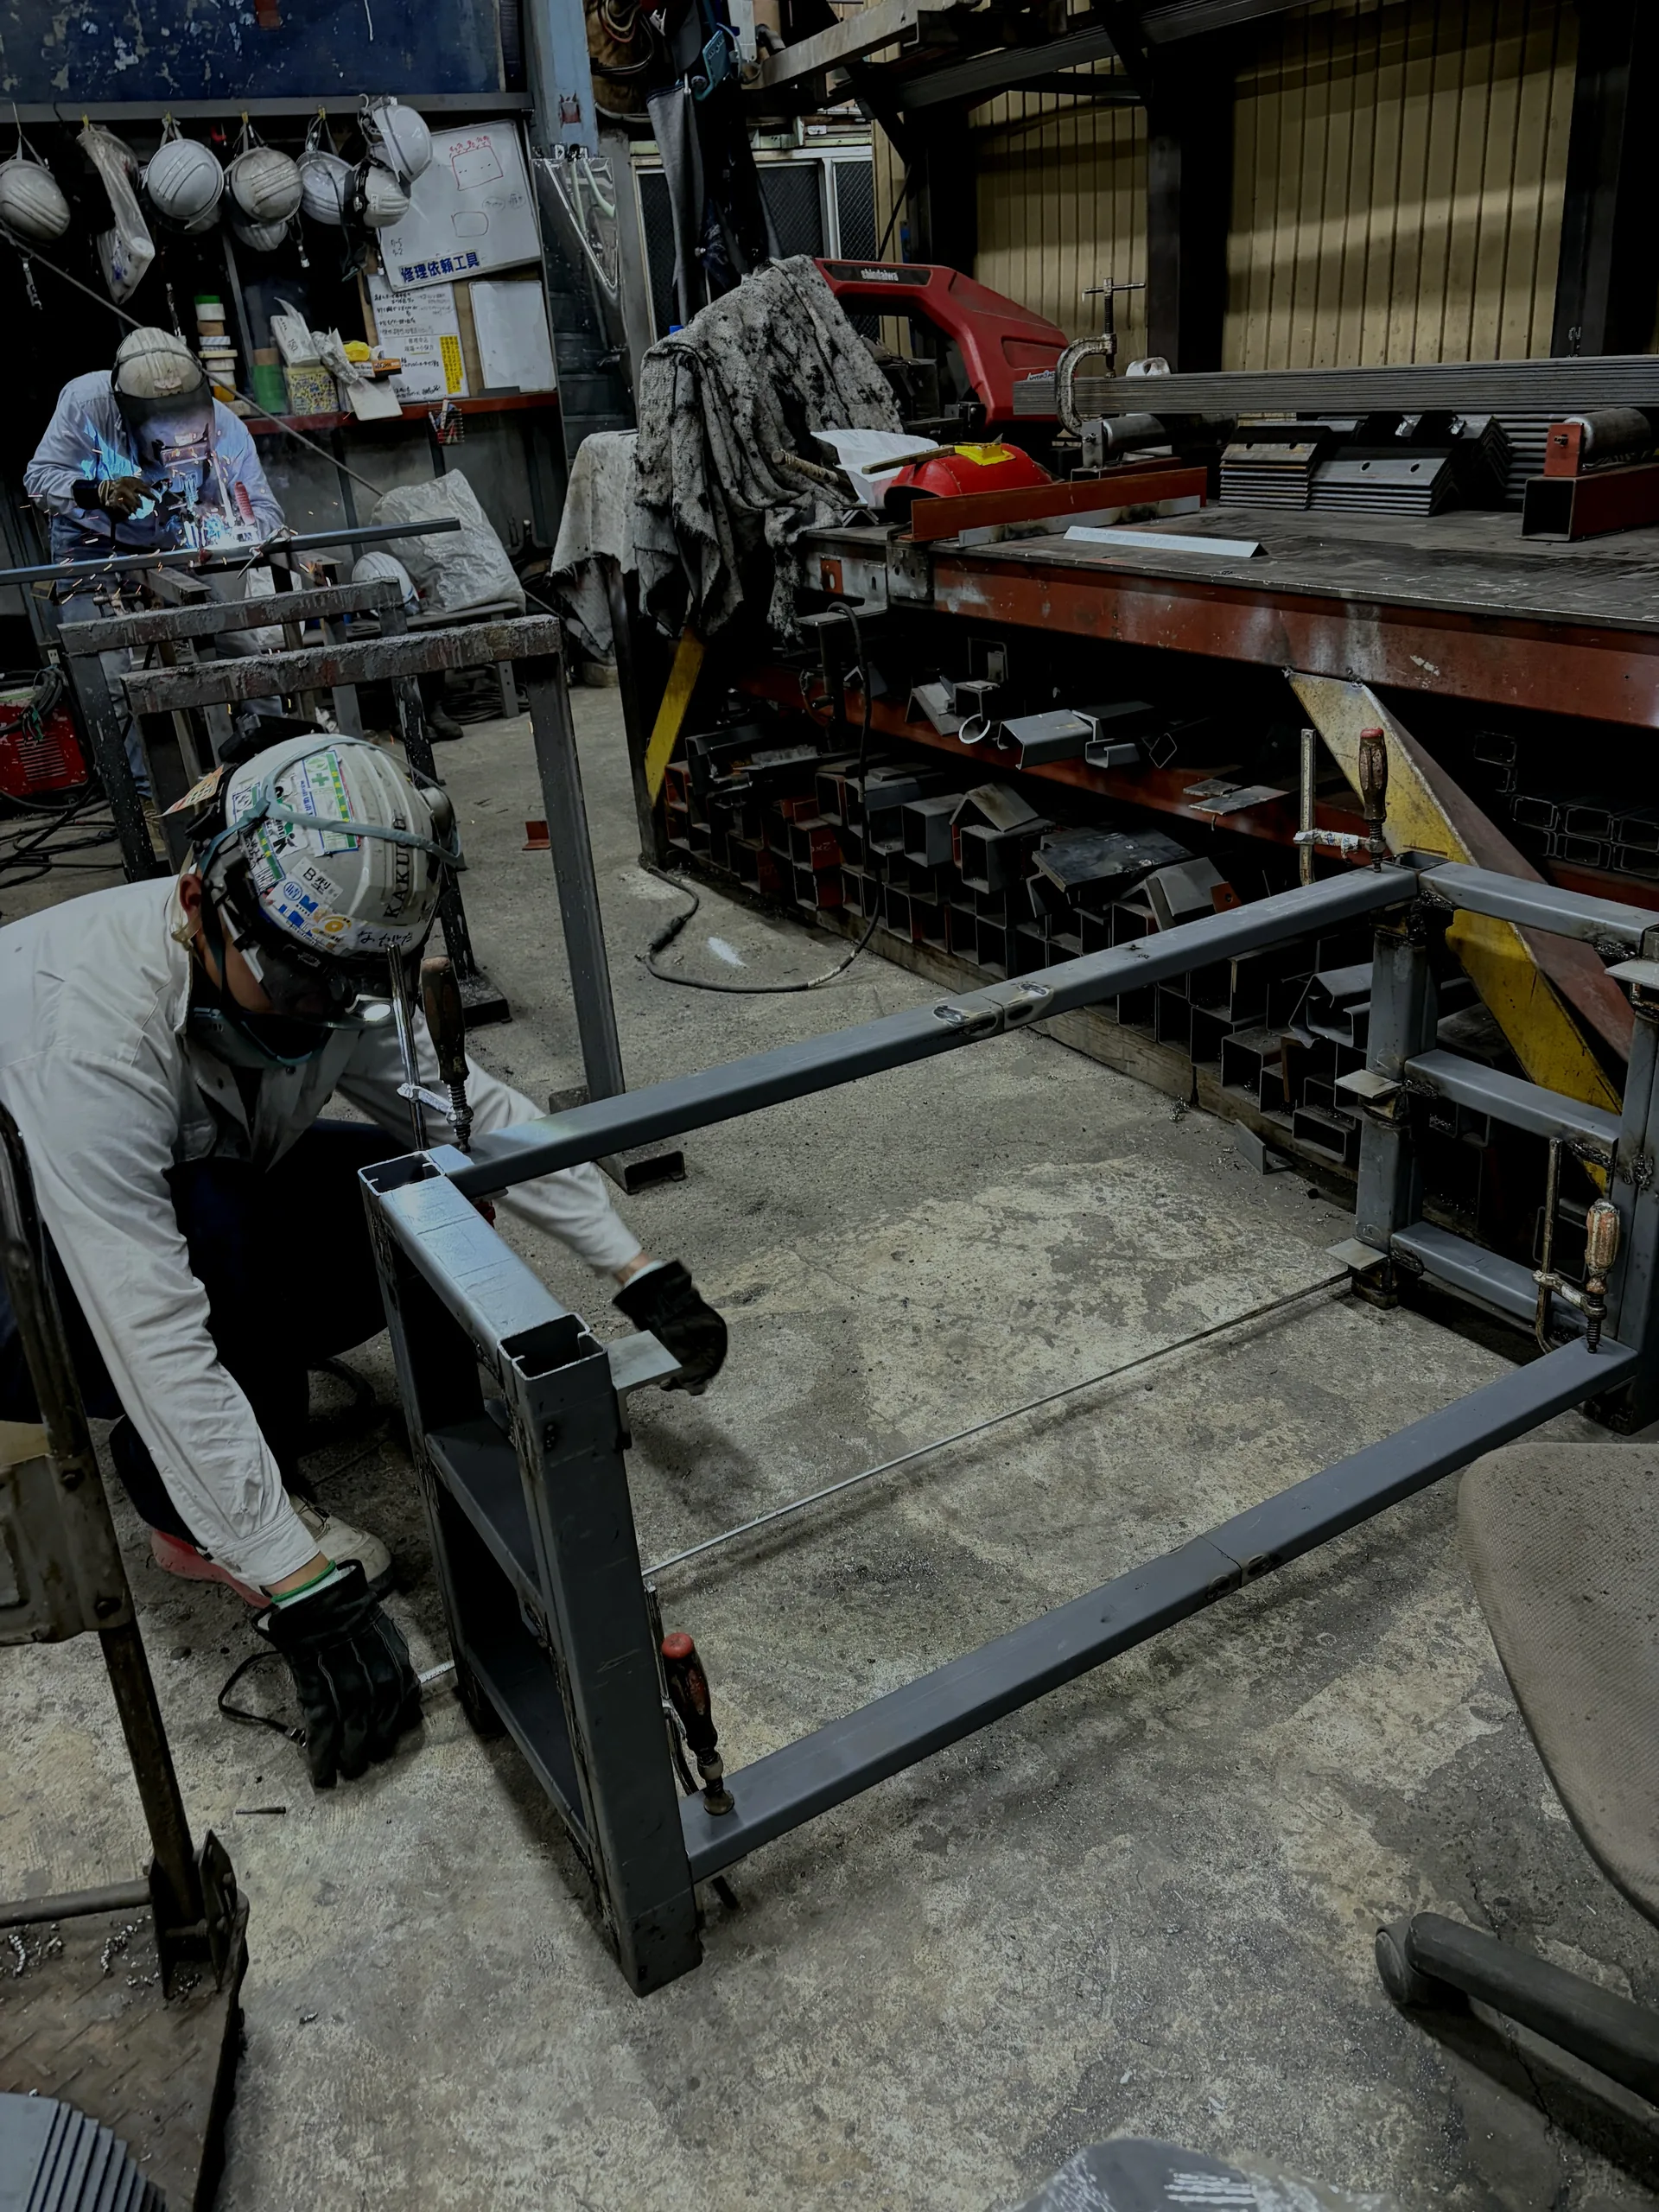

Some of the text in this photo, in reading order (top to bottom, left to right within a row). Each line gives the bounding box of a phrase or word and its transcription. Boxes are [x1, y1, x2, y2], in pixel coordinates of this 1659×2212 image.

[400, 251, 480, 283] 修理依頼工具
